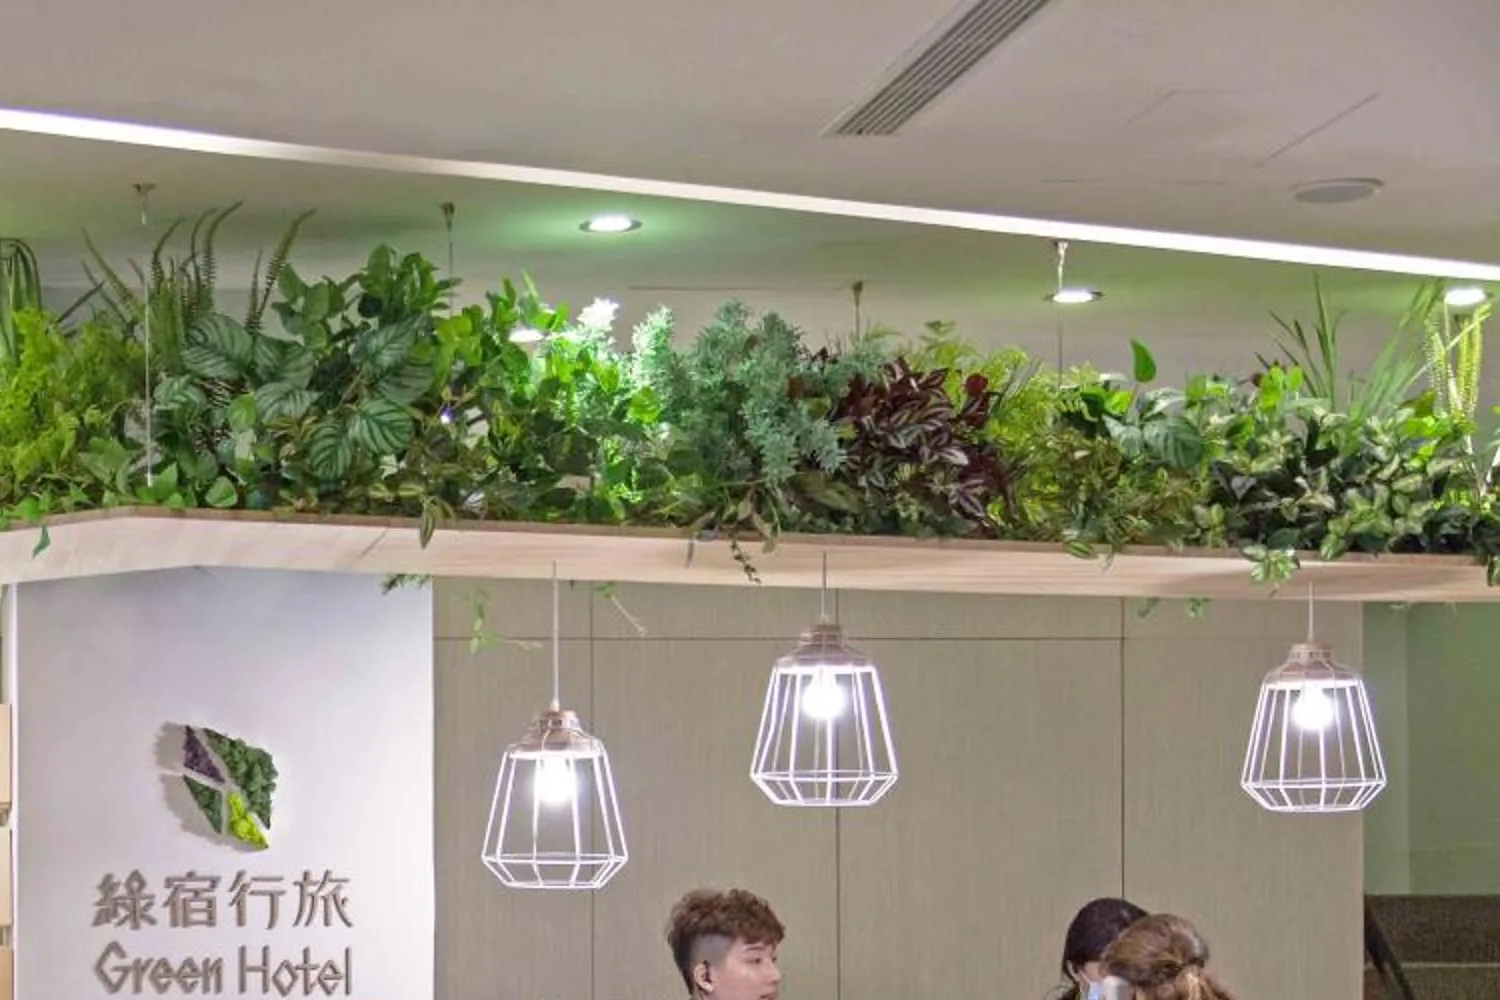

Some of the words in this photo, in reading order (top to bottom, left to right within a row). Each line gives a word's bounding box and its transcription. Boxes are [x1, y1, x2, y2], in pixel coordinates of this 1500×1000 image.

[90, 869, 354, 930] 綠宿行旅
[92, 941, 224, 995] Green
[238, 944, 352, 997] Hotel
